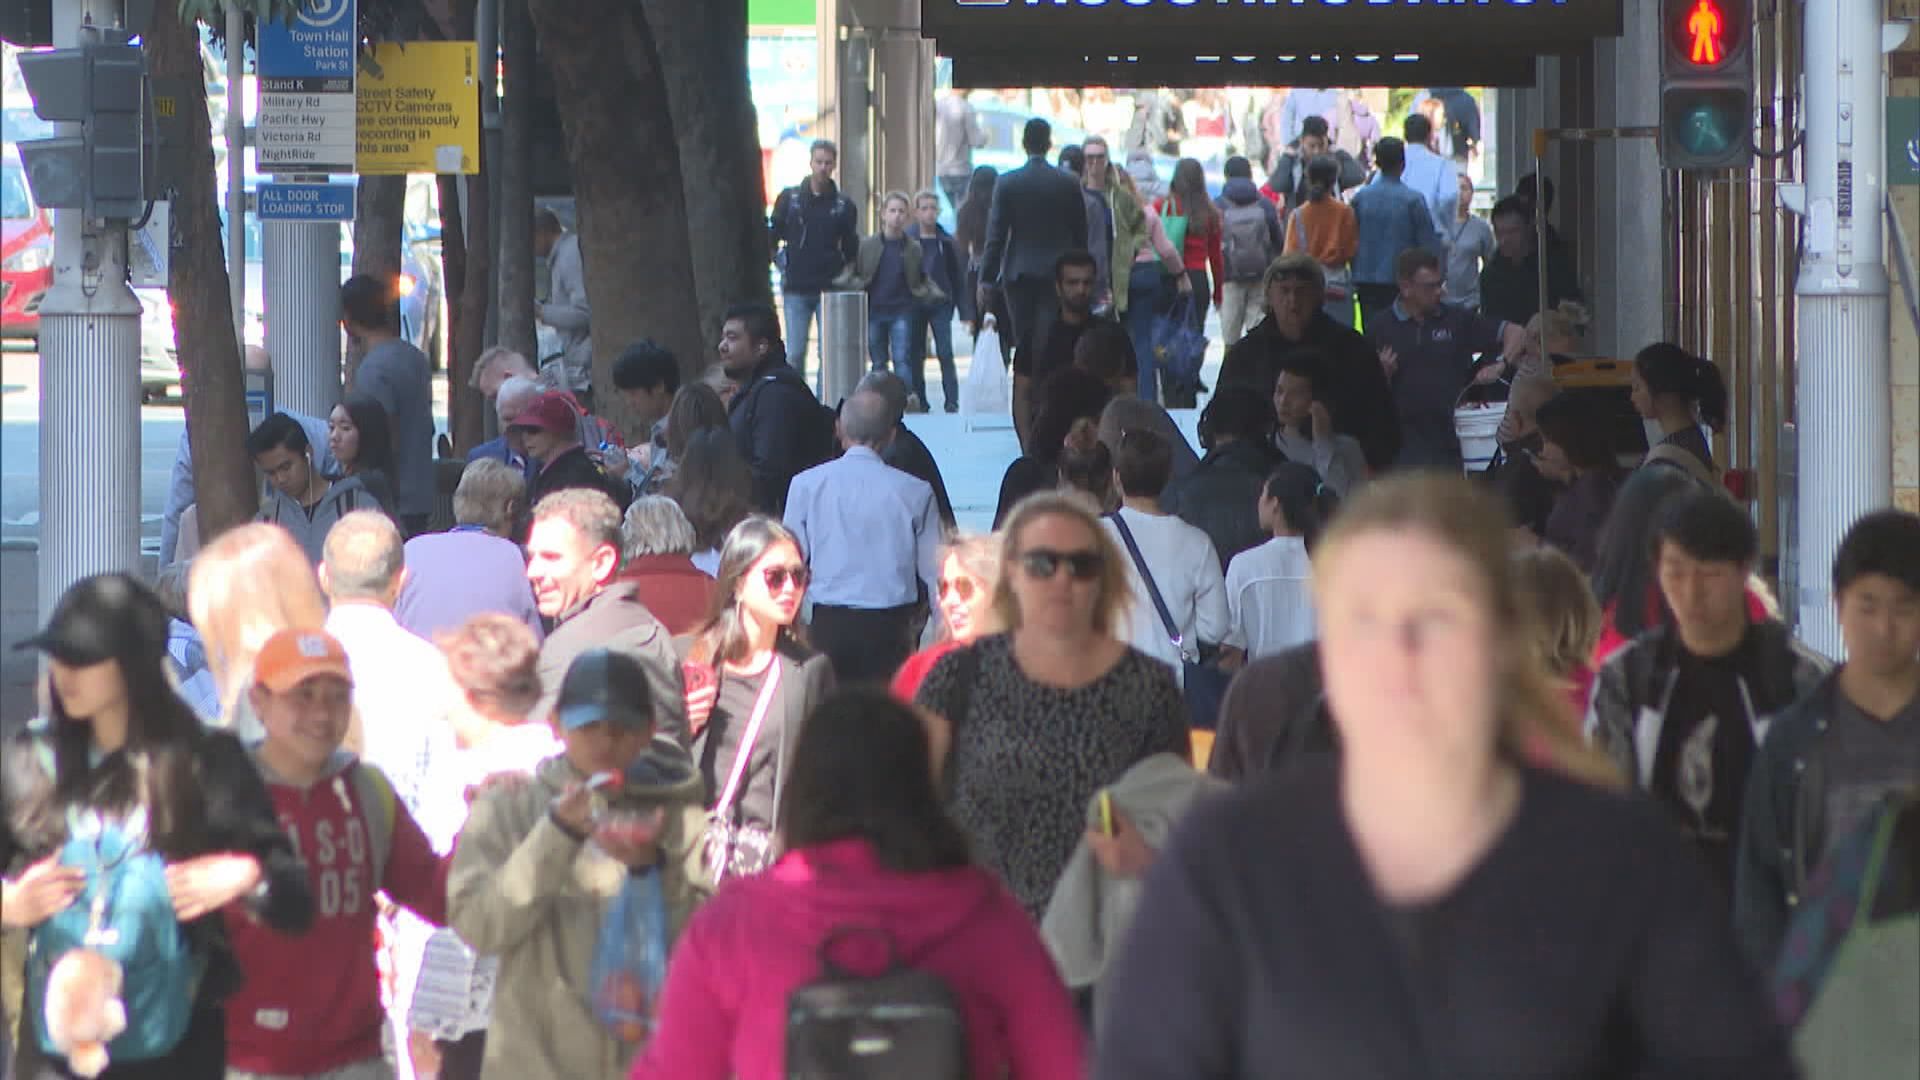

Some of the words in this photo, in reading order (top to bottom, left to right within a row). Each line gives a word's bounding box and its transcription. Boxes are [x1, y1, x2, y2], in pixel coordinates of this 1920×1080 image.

[291, 30, 321, 42] Town
[325, 30, 349, 42] Hall
[303, 45, 349, 58] Station
[316, 61, 336, 71] Park
[338, 60, 348, 71] St
[262, 80, 294, 90] Stand
[296, 80, 304, 90] K
[356, 88, 392, 98] Street
[395, 88, 436, 101] Safety
[262, 96, 303, 109] Military
[305, 96, 321, 107] Rd
[395, 101, 453, 113] Cameras
[262, 113, 299, 125] Pacific
[302, 114, 326, 126] Hwy
[378, 114, 460, 129] continuously
[262, 131, 305, 142] Victoria
[307, 131, 321, 142] Rd
[419, 129, 431, 140] in
[382, 143, 410, 153] area
[262, 148, 316, 161] NightRide
[263, 189, 283, 201] ALL
[287, 189, 320, 201] DOOR
[263, 203, 313, 215] LOADING
[316, 203, 345, 215] STOP
